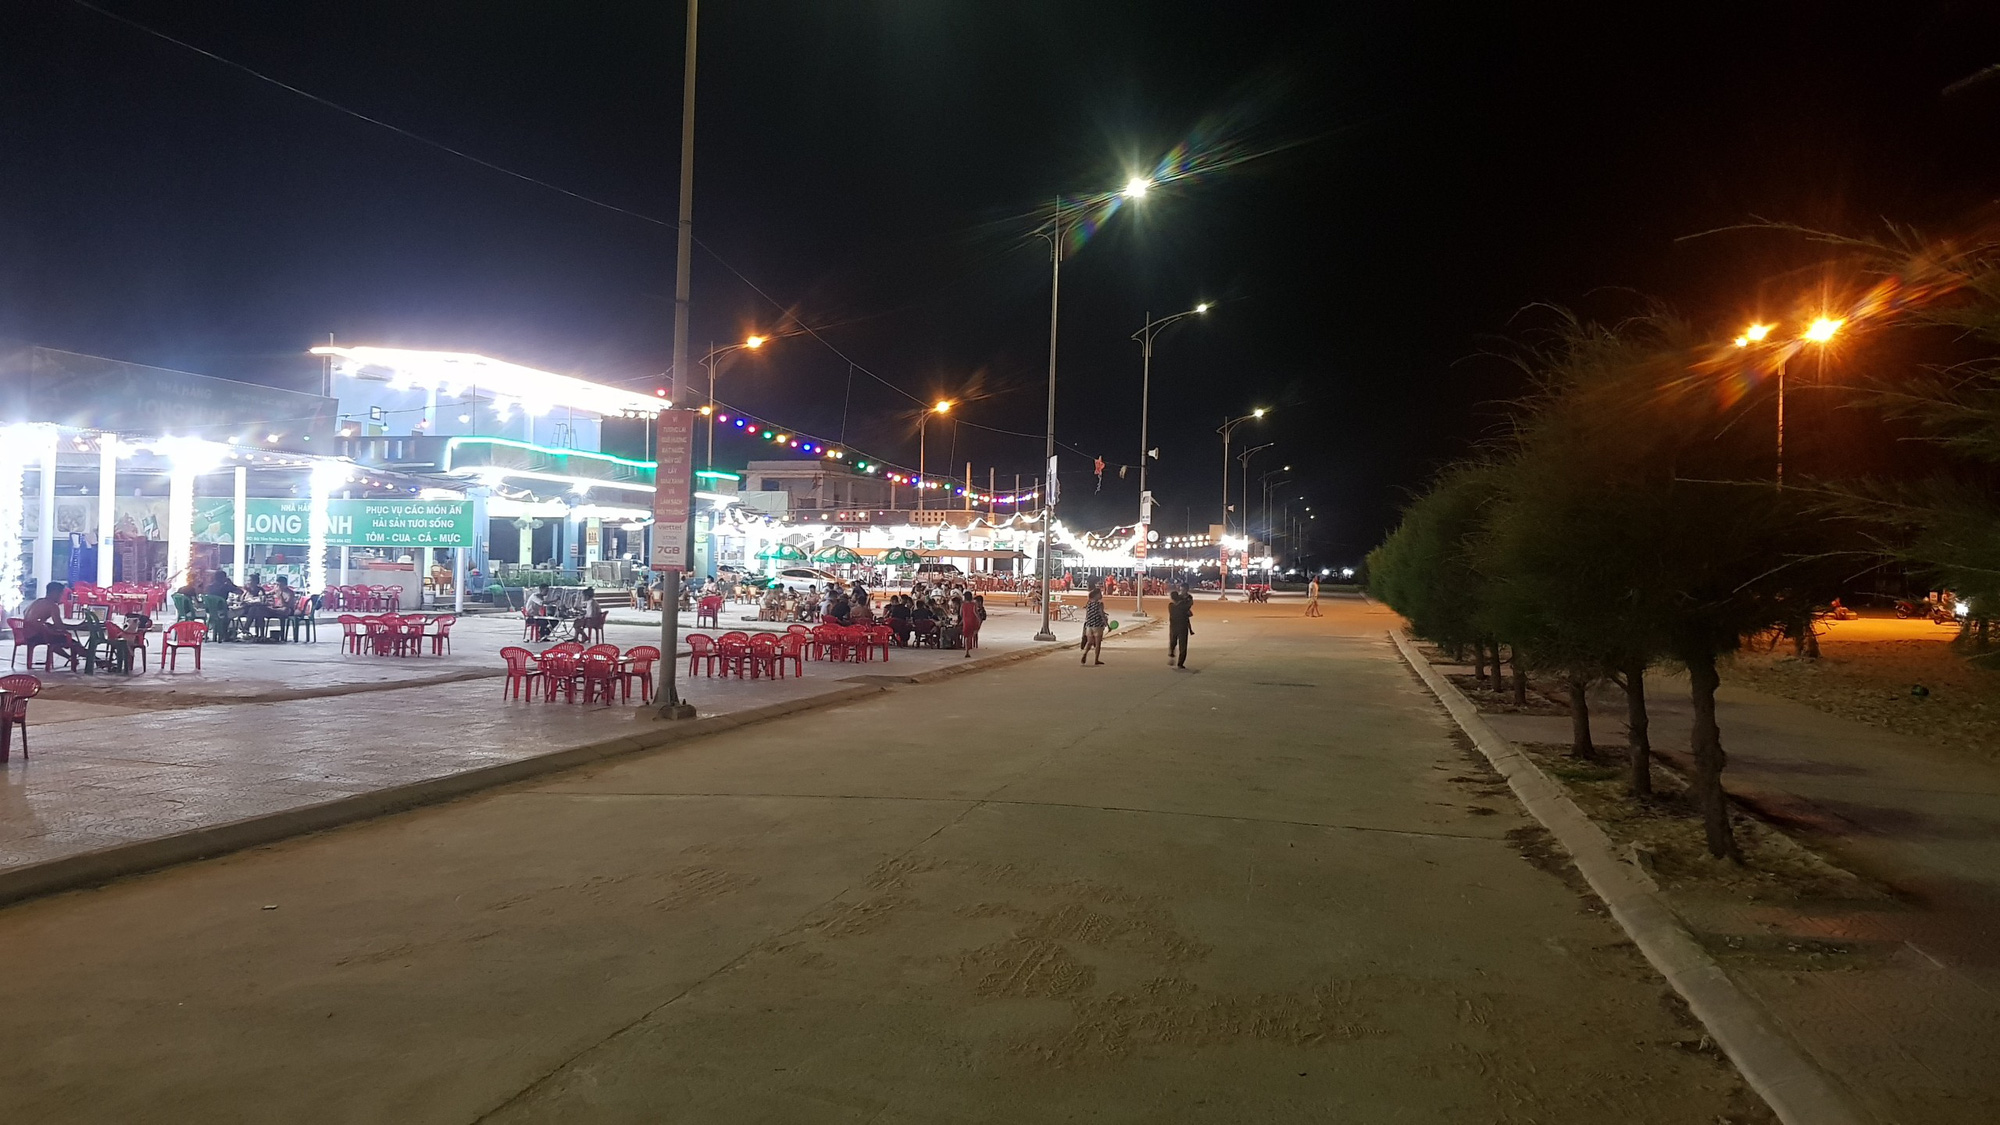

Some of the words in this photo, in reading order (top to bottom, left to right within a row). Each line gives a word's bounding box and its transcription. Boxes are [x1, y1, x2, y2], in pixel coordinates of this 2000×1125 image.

[280, 502, 296, 512] NHÀ
[366, 505, 390, 517] PHỤC
[391, 505, 403, 517] VỤ
[405, 503, 425, 515] CÁC
[427, 503, 447, 515] MÓN
[450, 503, 463, 515] ĂN
[246, 514, 302, 534] LONG
[373, 517, 387, 528] HẢI
[389, 517, 406, 528] SẢN
[408, 518, 427, 528] TƯƠI
[429, 517, 455, 529] SỐNG
[365, 531, 385, 542] TÔM
[391, 532, 410, 542] CUA
[418, 531, 432, 543] CÁ
[439, 533, 461, 545] MỰC
[657, 545, 680, 555] 7GB
